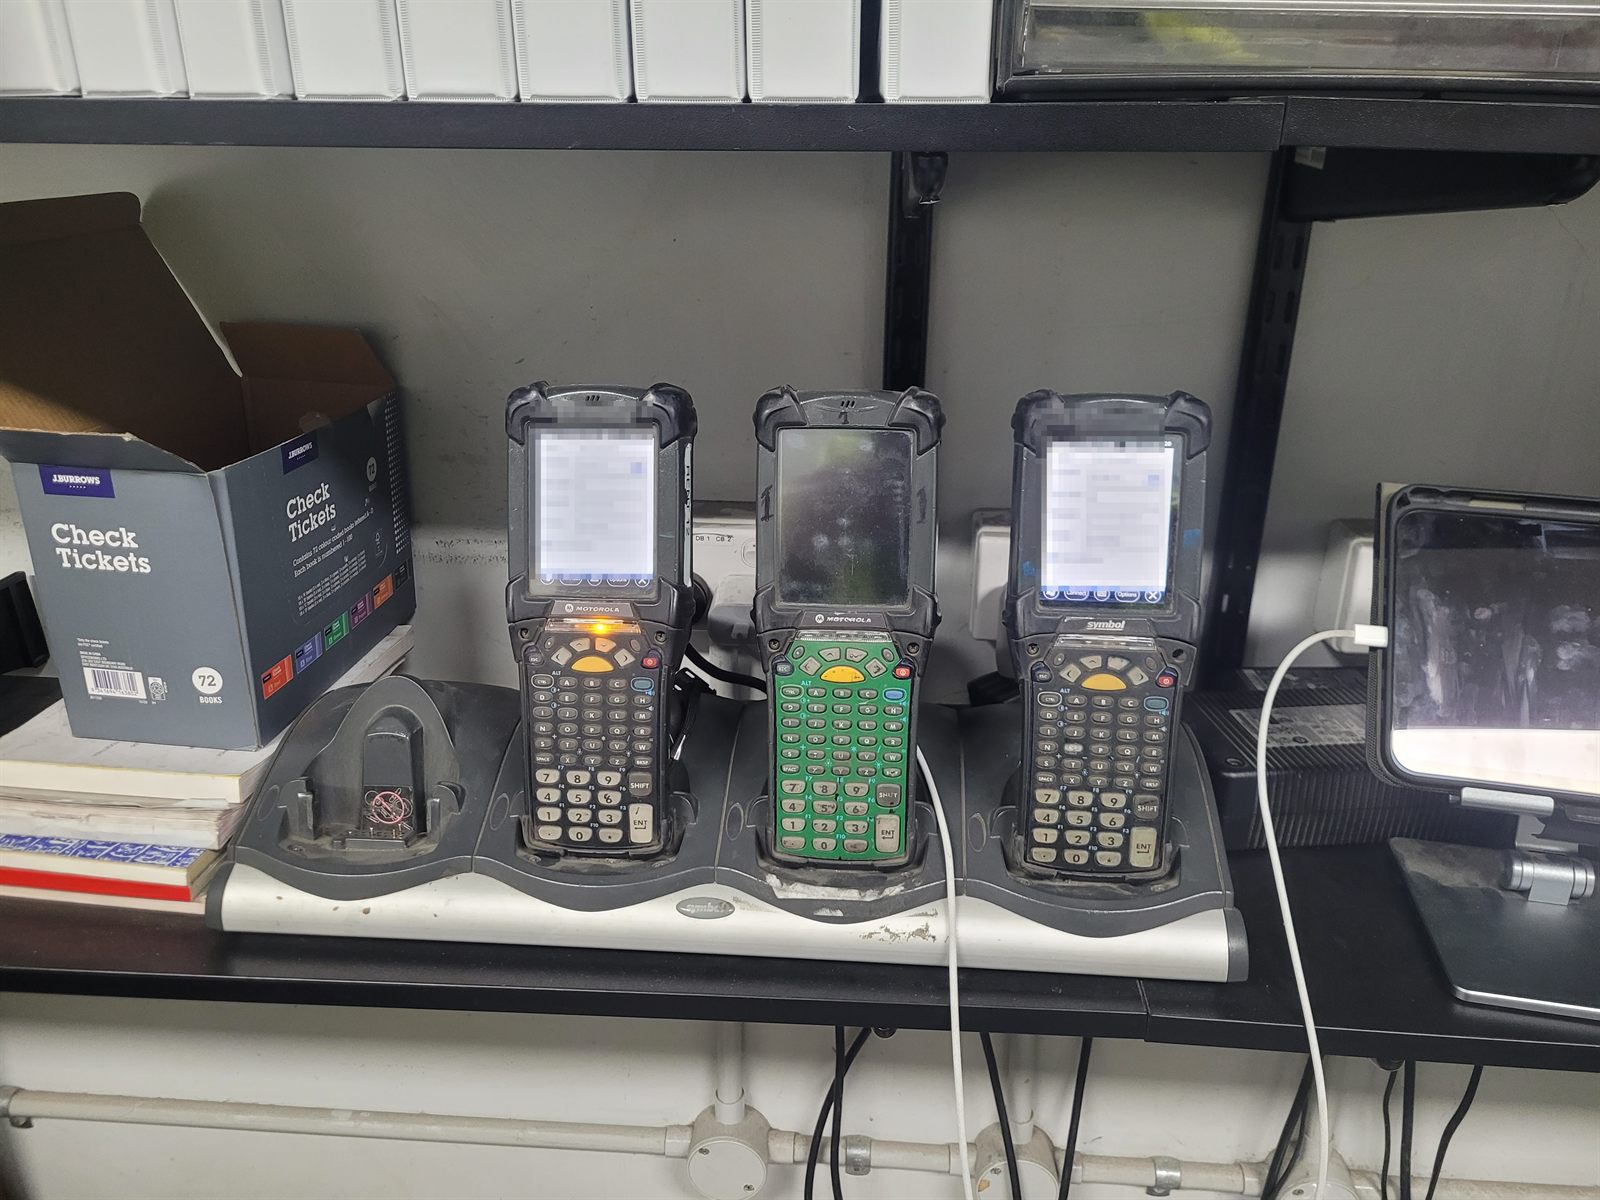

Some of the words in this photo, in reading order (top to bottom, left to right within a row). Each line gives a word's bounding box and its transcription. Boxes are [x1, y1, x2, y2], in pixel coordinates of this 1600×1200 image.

[288, 442, 312, 459] J.BURROWS
[52, 474, 100, 485] J.BURROWS
[286, 482, 330, 518] Check
[760, 484, 774, 522] 1
[288, 504, 336, 542] Tickets
[52, 524, 138, 548] Check
[56, 548, 151, 574] Tickets
[293, 551, 312, 566] Contains
[294, 566, 306, 577] Each
[306, 558, 317, 570] book
[1086, 620, 1126, 629] symbol
[198, 675, 216, 687] 72
[543, 774, 550, 782] 7
[574, 775, 581, 783] 8
[605, 776, 612, 784] 9
[790, 783, 797, 792] 7
[821, 785, 828, 793] 8
[853, 786, 860, 795] 9
[544, 793, 551, 801] 4
[575, 794, 582, 802] 5
[1044, 794, 1051, 802] 7
[1077, 796, 1084, 805] 8
[1110, 798, 1118, 806] 9
[789, 803, 796, 811] 4
[853, 806, 860, 814] 6
[576, 813, 582, 821] 2
[606, 814, 613, 822] 3
[1043, 814, 1050, 822] 4
[1076, 816, 1083, 824] 5
[1109, 818, 1116, 826] 6
[791, 821, 794, 829] 1
[821, 823, 828, 831] 2
[852, 824, 859, 832] 3
[576, 832, 583, 840] 0
[1044, 833, 1048, 842] 1
[1075, 835, 1082, 844] 2
[1108, 837, 1115, 845] 3
[821, 842, 827, 850] 0
[1073, 854, 1080, 863] 0
